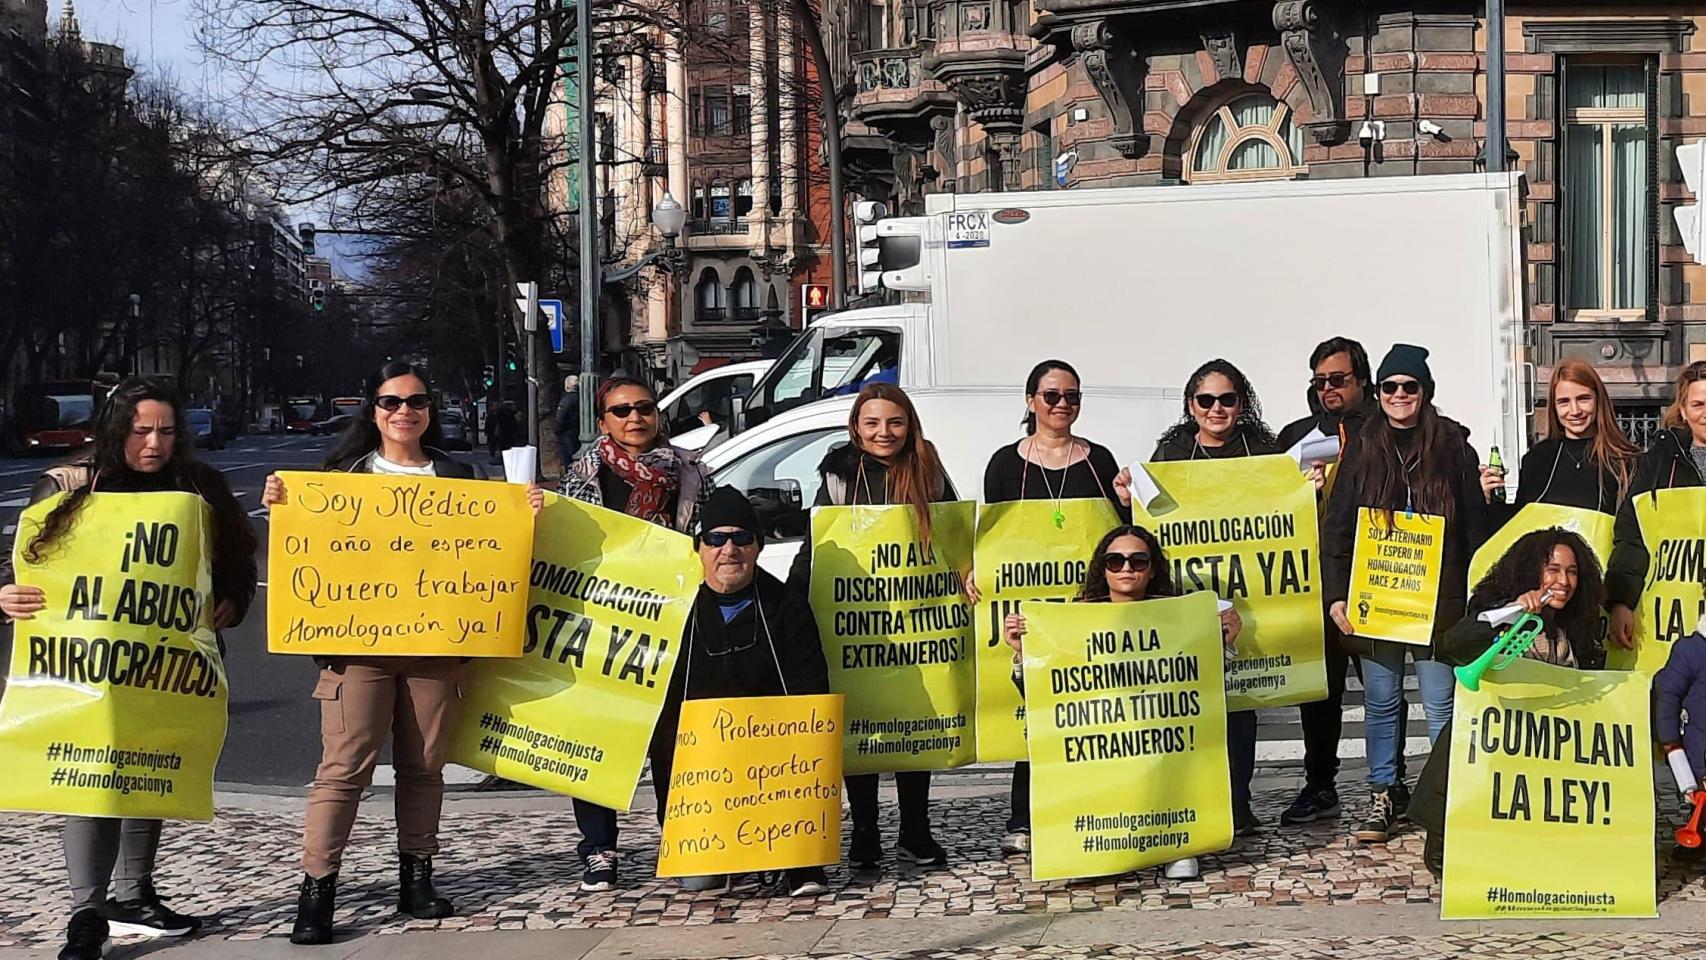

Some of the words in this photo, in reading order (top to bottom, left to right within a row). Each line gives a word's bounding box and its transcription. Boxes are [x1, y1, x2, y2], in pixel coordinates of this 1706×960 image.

[948, 213, 987, 231] FRCX
[299, 483, 362, 526] Soy
[376, 483, 497, 527] Médico
[120, 522, 179, 572] ¡NO
[1154, 511, 1295, 547] HOMOLOGACIÓN
[285, 536, 308, 554] 01
[330, 536, 372, 552] año
[390, 536, 413, 552] de
[431, 537, 502, 559] espera
[871, 543, 901, 575] ¡NO
[906, 542, 918, 568] A
[1377, 544, 1382, 555] Y
[1383, 545, 1412, 559] ESPERO
[1413, 551, 1424, 560] MI
[1647, 539, 1705, 592] ¡CUM
[292, 565, 398, 608] Quiero
[415, 568, 520, 603] trabajar
[531, 558, 666, 622] OMOLOGACIÓN
[834, 567, 966, 603] DISCRIMINACIÓN
[995, 561, 1086, 594] ¡HOMOLOG
[1256, 549, 1311, 597] YA!
[1368, 575, 1389, 588] HACE
[1390, 577, 1399, 590] 2
[66, 575, 107, 620] AL
[282, 612, 443, 647] Homologación
[834, 610, 906, 637] CONTRA
[909, 603, 970, 634] TÍTULOS
[1655, 597, 1685, 642] LA
[523, 604, 593, 668] STA
[601, 625, 668, 688] YA!
[1086, 631, 1117, 662] ¡NO
[1122, 630, 1134, 653] A
[1138, 628, 1161, 652] LA
[1051, 651, 1199, 695] DISCRIMINACIÓN
[1225, 653, 1292, 675] gacionjusta
[849, 713, 966, 736] #Homologacionjusta
[1055, 696, 1126, 729] CONTRA
[1129, 689, 1201, 723] TÍTULOS
[480, 712, 604, 763] #Homologacionjusta
[858, 735, 961, 755] #Homologacionya
[1467, 706, 1635, 768] ¡CUMPLAN
[47, 742, 182, 771] #Homologacionjusta
[480, 735, 589, 783] #Homologacionya
[671, 767, 733, 791] ueremos
[747, 753, 823, 790] aportar
[51, 767, 173, 797] #Homologacionya
[664, 796, 713, 821] estros
[724, 778, 839, 811] conocimientos
[1491, 771, 1531, 821] LA
[1543, 776, 1612, 826] LEY!
[1074, 807, 1197, 833] #Homologacionjusta
[679, 828, 726, 855] más
[1083, 830, 1190, 853] #Homologacionya
[1487, 886, 1616, 907] #Homologacionjusta
